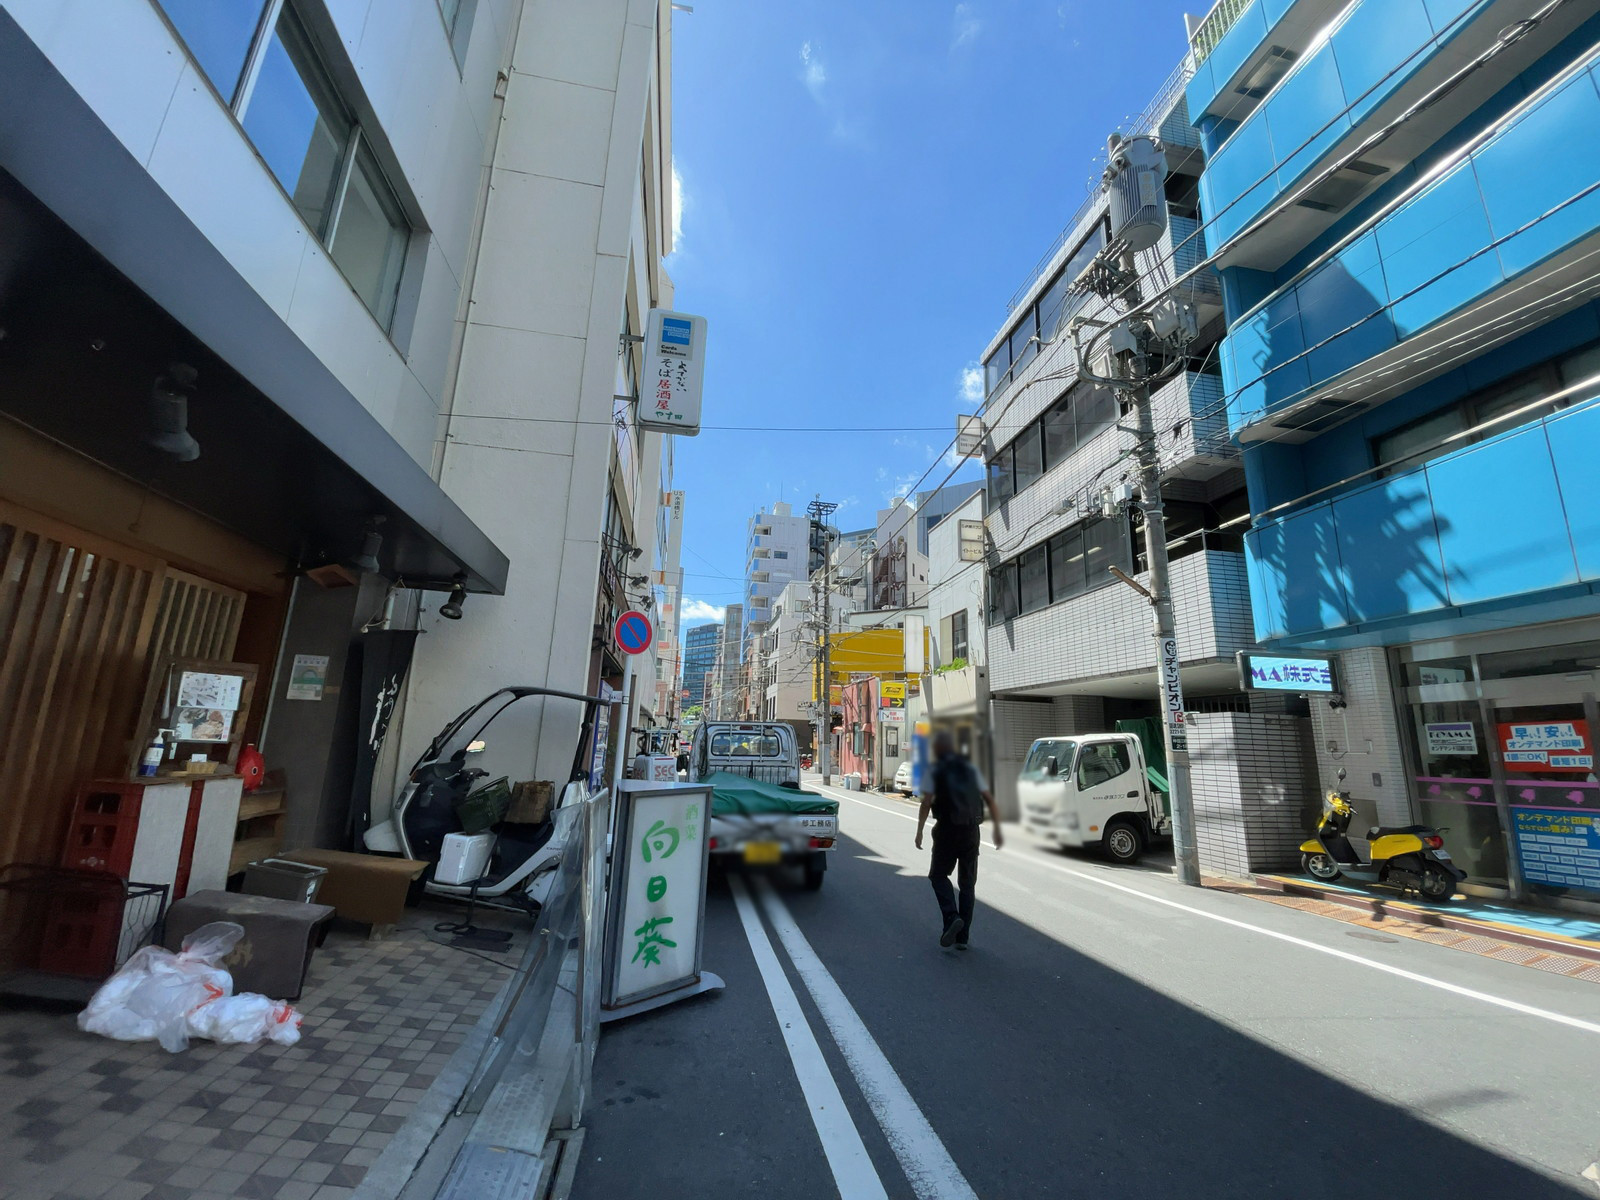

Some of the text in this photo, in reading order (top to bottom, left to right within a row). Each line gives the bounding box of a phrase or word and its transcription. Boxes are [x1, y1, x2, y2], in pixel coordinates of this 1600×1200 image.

[655, 358, 674, 410] そば居酒屋
[1509, 739, 1582, 748] オンデマンド印刷
[631, 820, 680, 969] 向日葵
